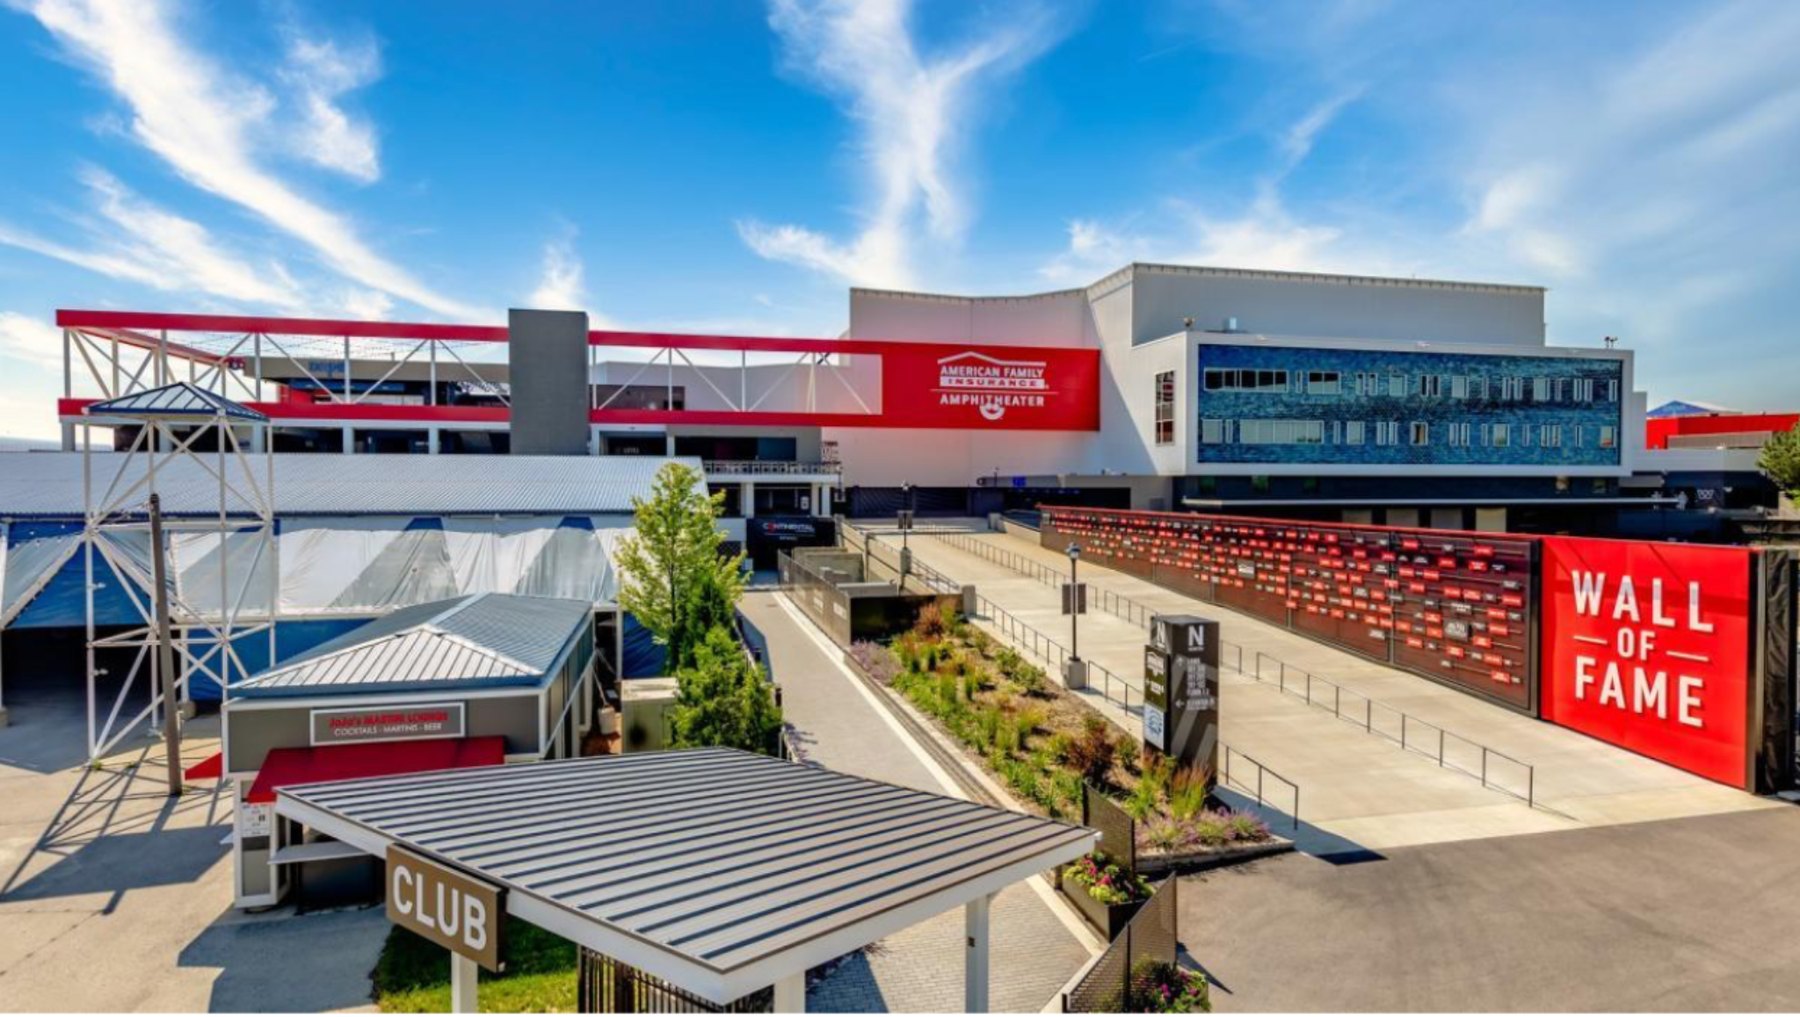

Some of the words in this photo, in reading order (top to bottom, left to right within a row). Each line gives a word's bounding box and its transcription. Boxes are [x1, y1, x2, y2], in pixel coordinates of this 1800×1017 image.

[940, 365, 1000, 378] AMERICAN
[1003, 367, 1044, 379] FAMILY
[948, 378, 1038, 387] INSURANCE
[940, 393, 1045, 407] AMPHITHEATER
[1571, 569, 1714, 633] WALL
[1188, 625, 1205, 647] N
[1617, 627, 1656, 661] OF
[1574, 655, 1704, 727] FAME
[334, 726, 377, 737] COCKTAILS
[383, 723, 418, 733] MARTINIS
[423, 721, 442, 731] BEER
[393, 865, 487, 951] CLUB
